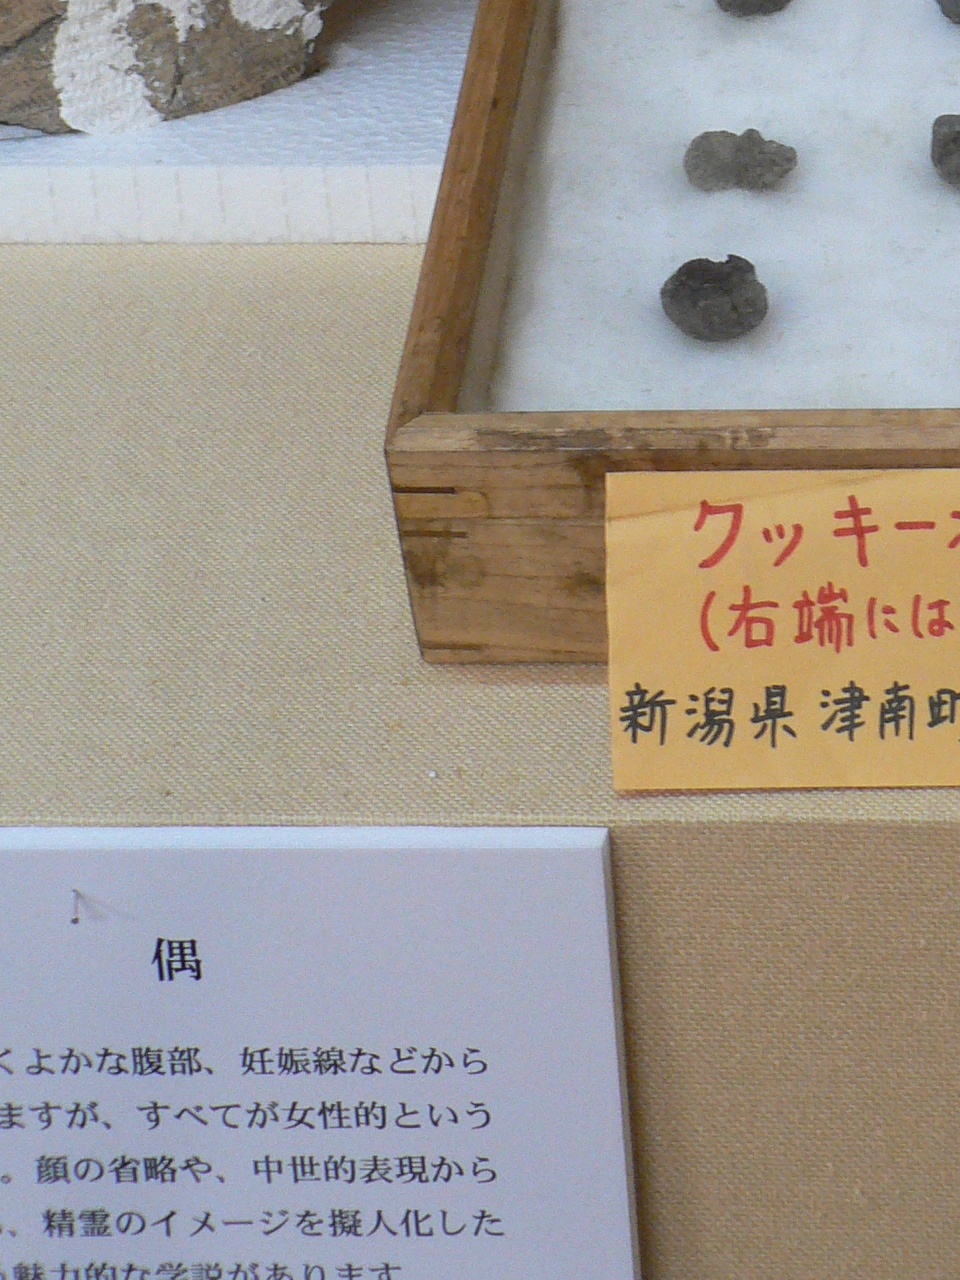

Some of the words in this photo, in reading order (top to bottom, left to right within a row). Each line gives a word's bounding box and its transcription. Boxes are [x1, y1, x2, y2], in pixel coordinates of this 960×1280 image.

[151, 937, 203, 983] 偶
[0, 1100, 491, 1131] ますが、すべてが女性的という
[0, 1208, 505, 1239] 、精霊のイメージを擬人化した
